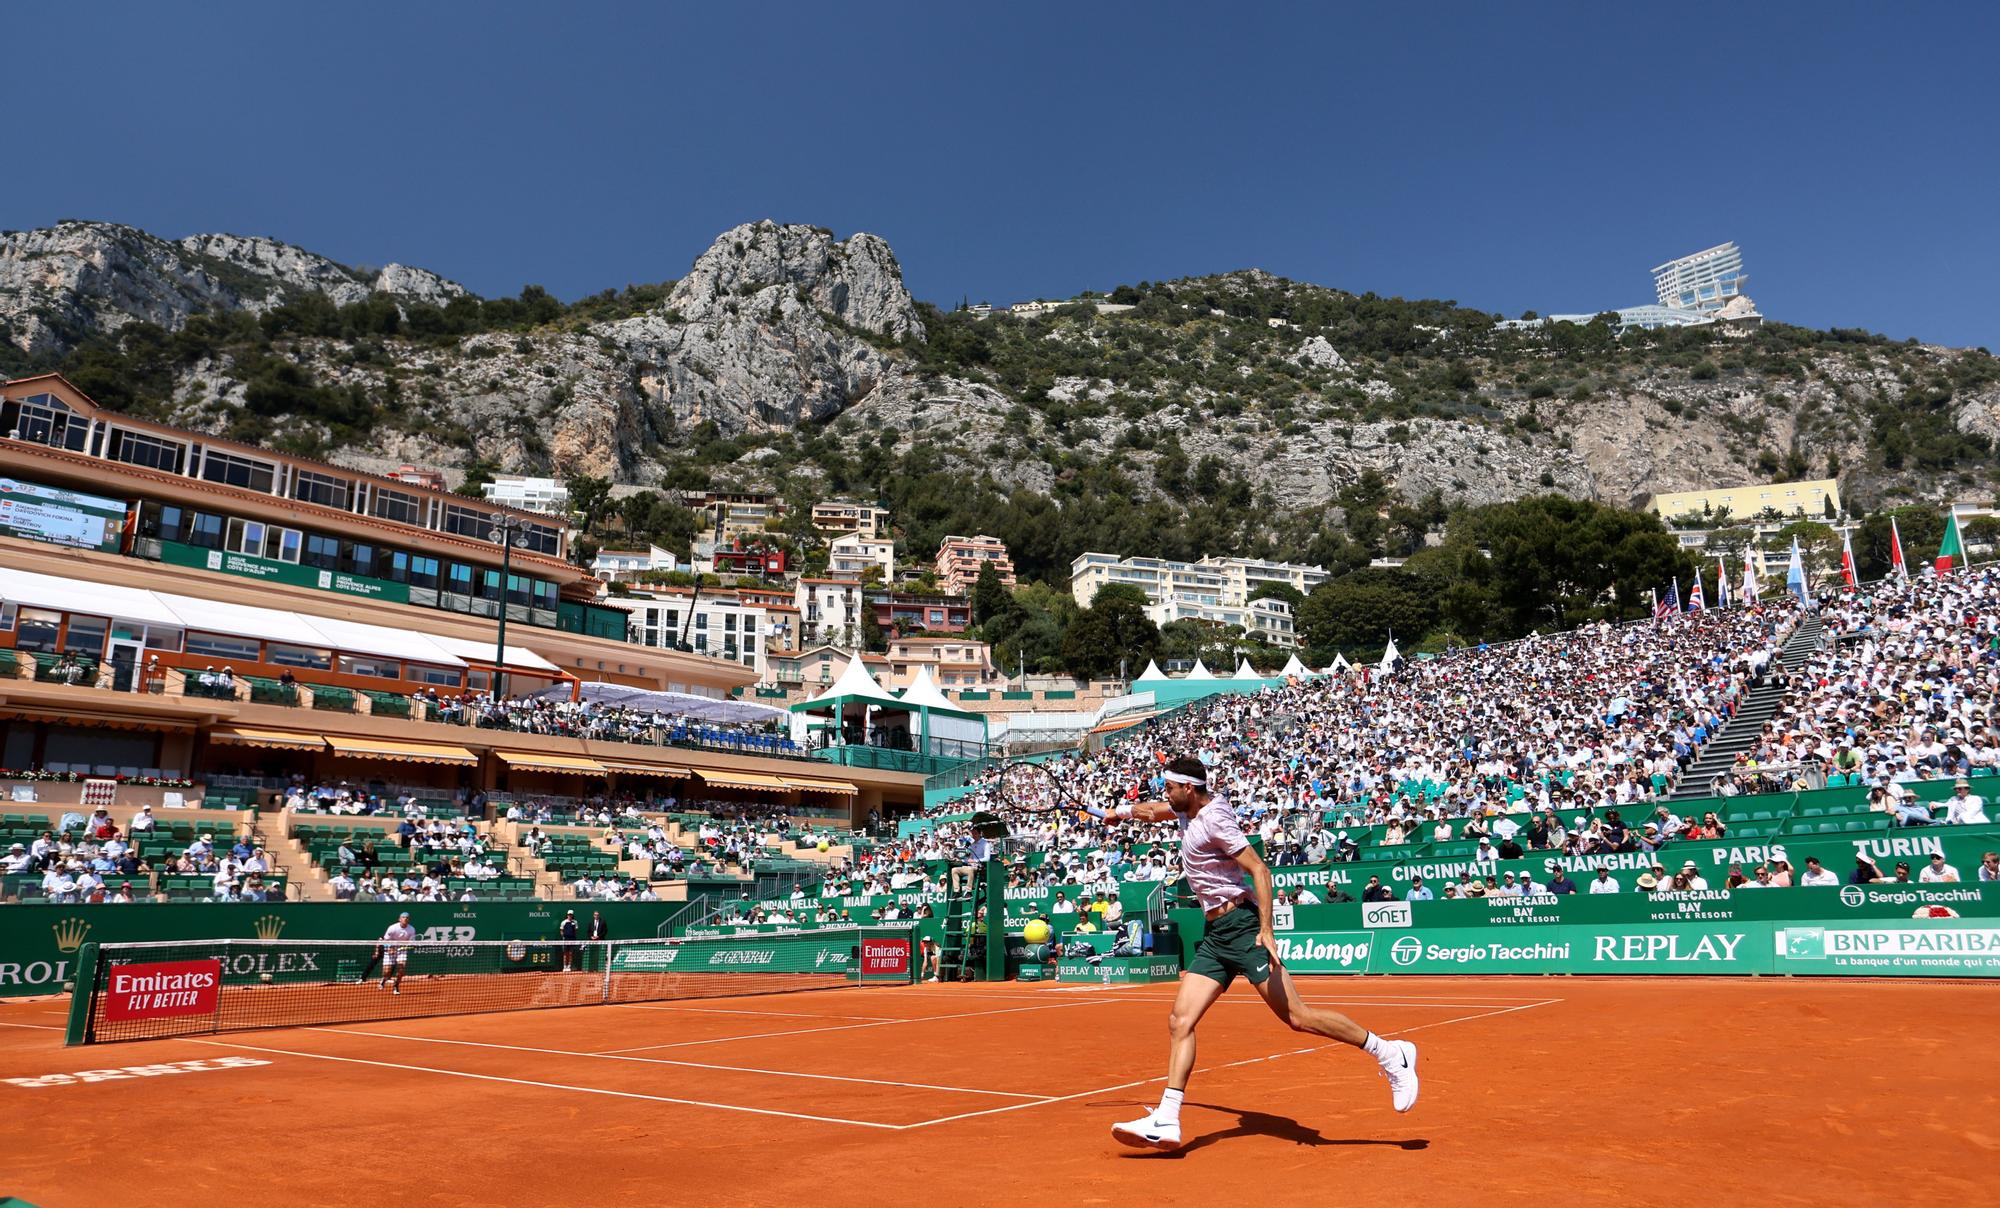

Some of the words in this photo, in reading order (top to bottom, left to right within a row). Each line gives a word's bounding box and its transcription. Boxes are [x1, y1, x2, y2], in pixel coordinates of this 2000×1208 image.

[228, 560, 260, 569] PROVENCE
[336, 580, 364, 588] PROVENCE
[1853, 836, 1943, 857] TURIN
[1713, 844, 1788, 865] PARIS
[1544, 852, 1658, 874] SHANGHAI
[1392, 861, 1497, 882] CINCINNATI
[1004, 888, 1048, 900] MADRID
[1083, 883, 1120, 896] ROME
[844, 896, 871, 908] MIAMI
[1488, 895, 1558, 907] MONTE-CARLO
[1648, 890, 1730, 902] MONTE-CARLO
[1869, 891, 1916, 904] Sergio
[1916, 889, 1982, 902] Tacchini
[760, 900, 790, 911] INDIAN
[790, 898, 818, 910] WELLS
[1678, 902, 1702, 913] BAY
[1514, 908, 1534, 917] BAY
[884, 921, 920, 930] DUNLOP
[1004, 916, 1030, 928] decco
[421, 926, 476, 945] ATP
[1593, 934, 1746, 961] REPLAY
[1834, 934, 1890, 951] BNP
[1901, 933, 2000, 951] PARIBA
[725, 950, 776, 964] GENERALI
[865, 946, 905, 958] Emirates
[1276, 938, 1368, 966] Malongo
[1426, 944, 1486, 963] Sergio
[1488, 942, 1570, 960] Tacchini
[209, 952, 320, 975] ROLEX
[880, 958, 899, 968] BETTER
[1835, 958, 1848, 966] La
[1850, 957, 1890, 968] banque
[1894, 957, 1916, 966] d'un
[1921, 958, 1960, 966] monde
[1964, 958, 1983, 968] qui
[1060, 966, 1090, 976] REPLAY
[1094, 966, 1126, 976] REPLAY
[1151, 964, 1178, 976] REPLAY
[115, 972, 214, 994] Emirates
[128, 994, 151, 1010] FLY
[153, 990, 198, 1008] BETTER
